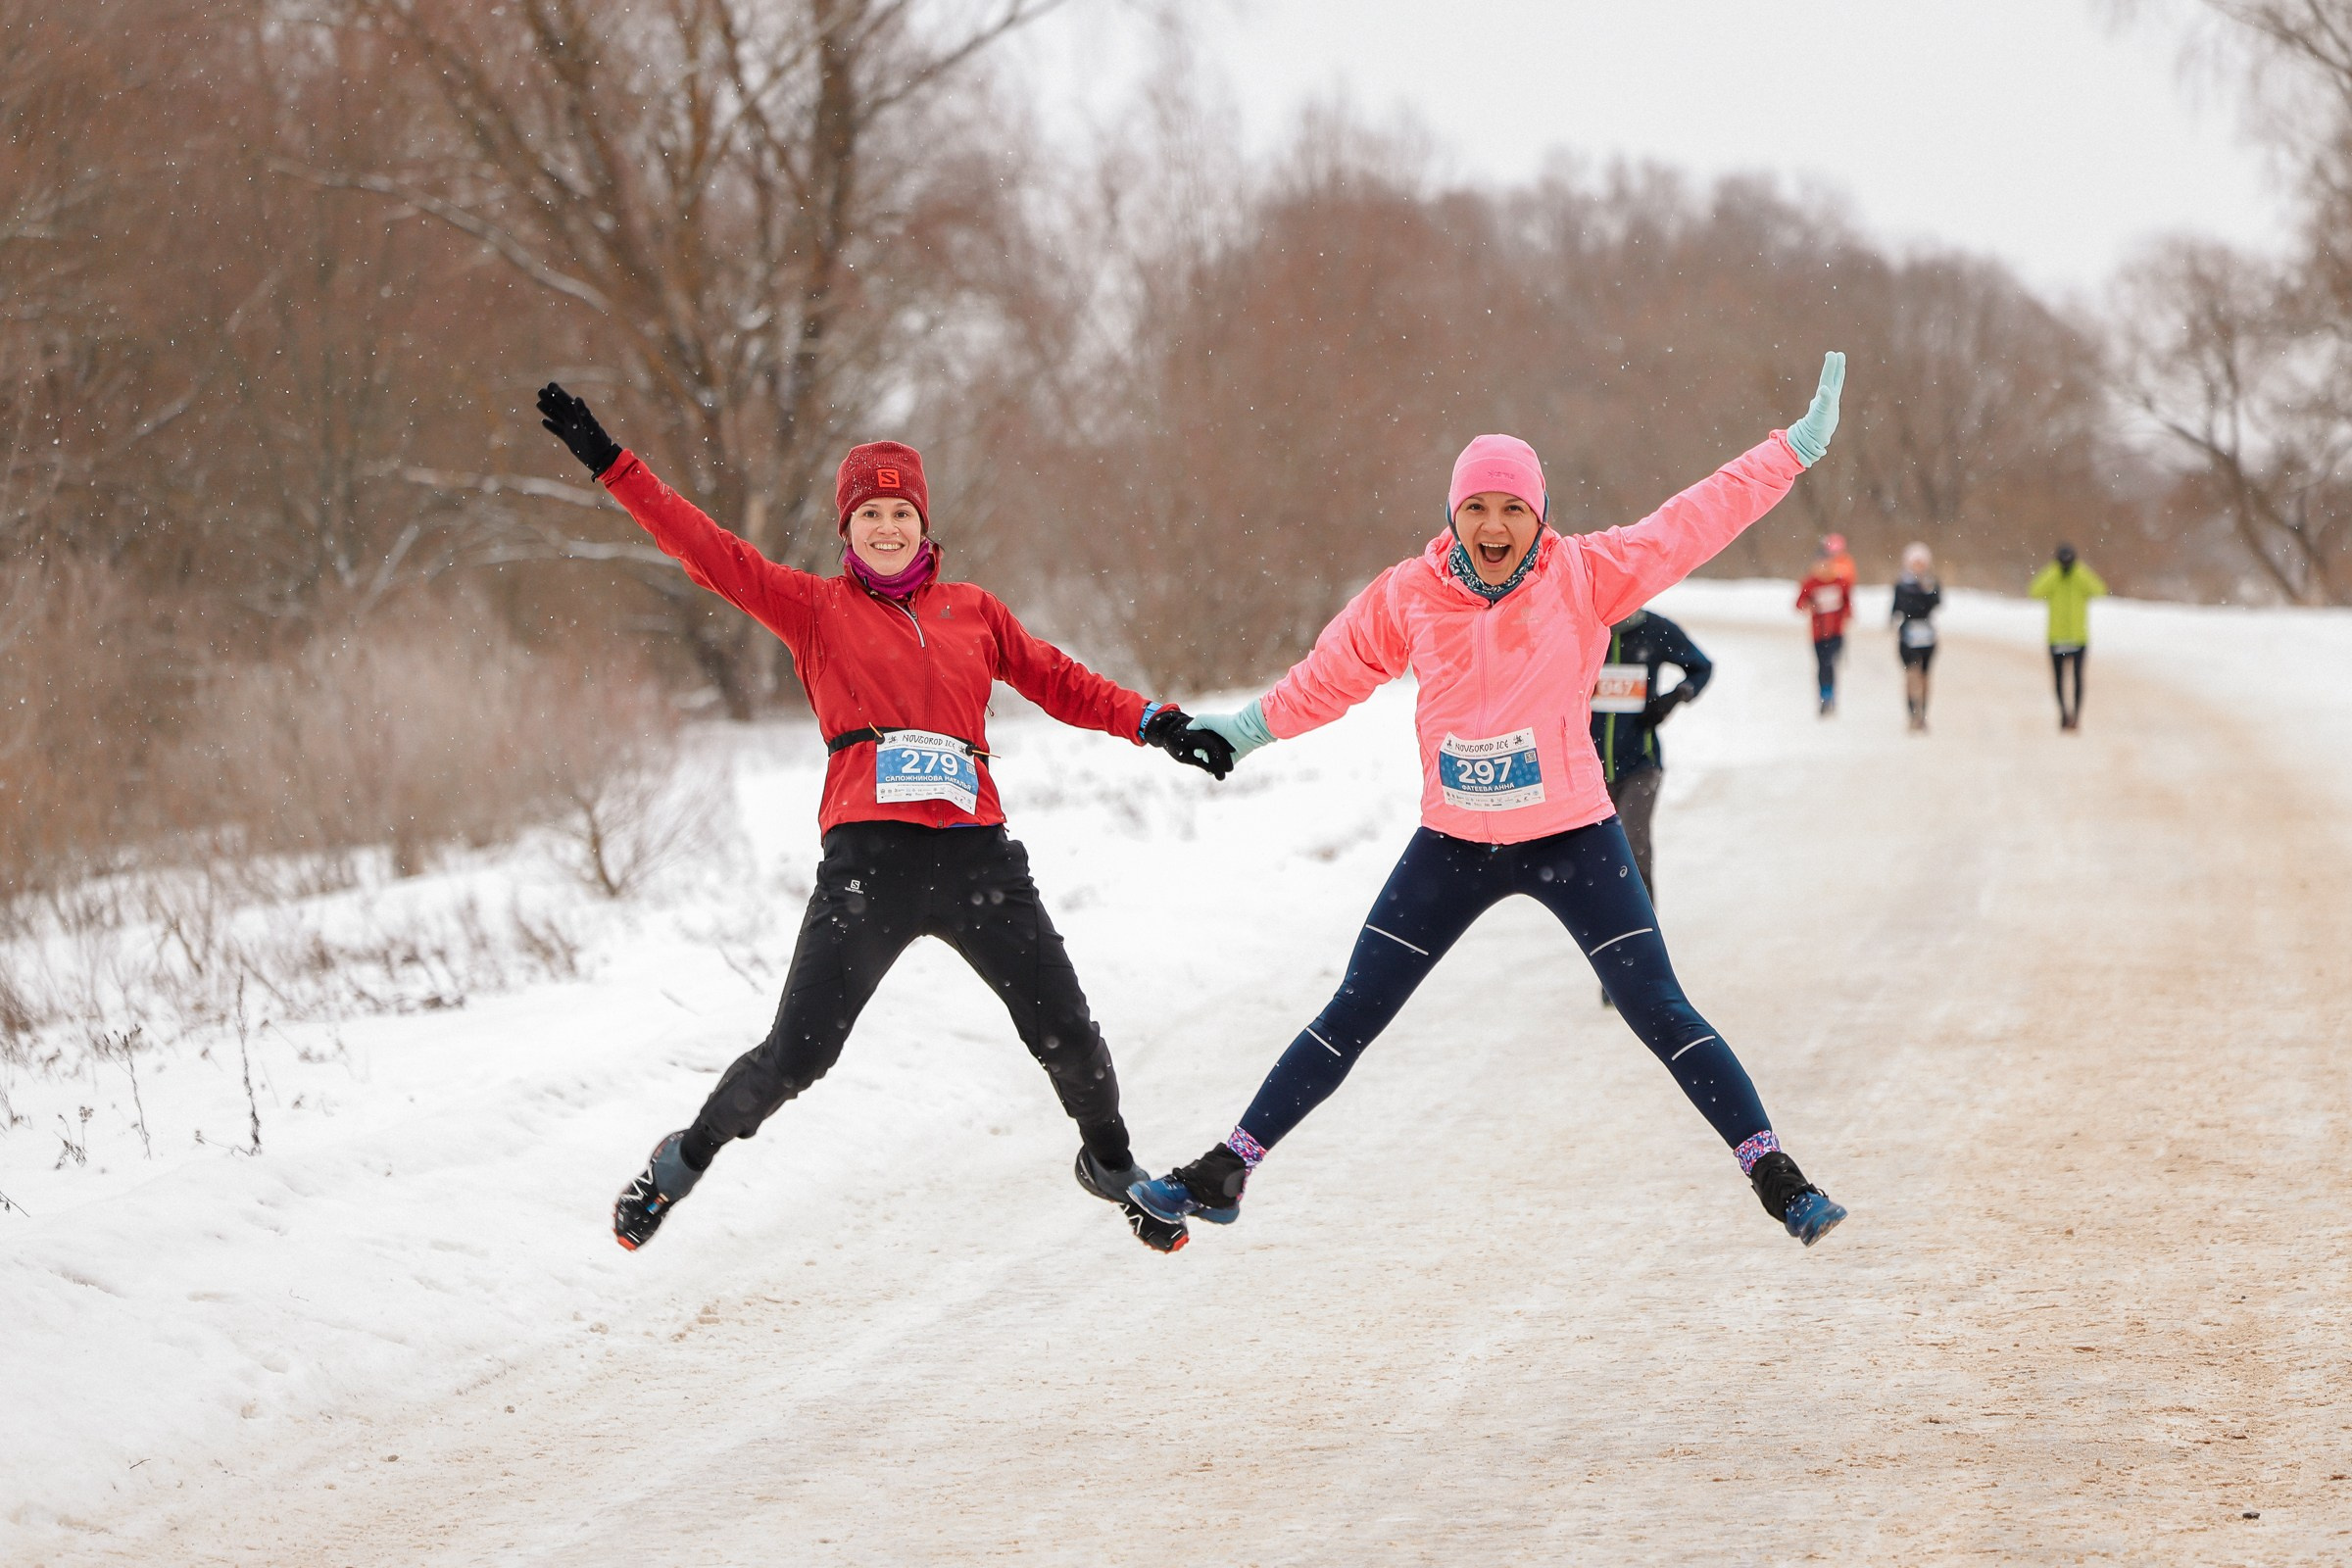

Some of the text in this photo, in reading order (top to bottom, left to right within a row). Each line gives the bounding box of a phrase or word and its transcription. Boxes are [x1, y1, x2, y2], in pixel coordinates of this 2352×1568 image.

[880, 471, 897, 485] S
[901, 750, 958, 776] 279
[1456, 756, 1512, 785] 297
[945, 775, 972, 791] НАТАЛЬЯ
[1494, 782, 1515, 792] АННА
